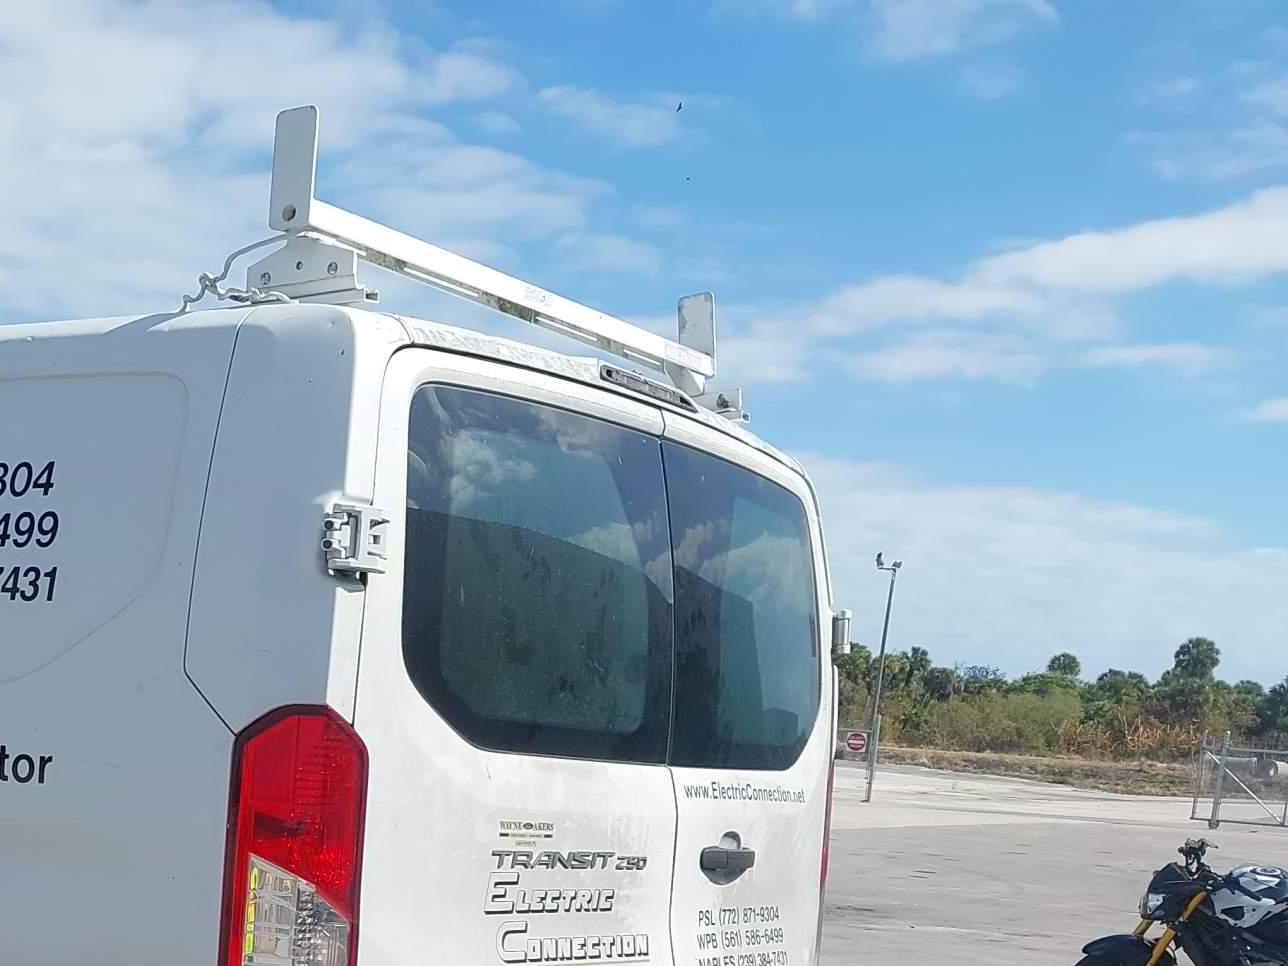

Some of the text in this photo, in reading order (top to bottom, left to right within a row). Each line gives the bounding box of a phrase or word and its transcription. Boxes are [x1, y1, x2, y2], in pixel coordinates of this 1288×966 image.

[684, 781, 806, 803] www.ElectricConnection.net
[533, 823, 554, 831] AKERS
[491, 851, 616, 870] TRANSIT
[484, 872, 615, 915] ELECTRIC
[698, 906, 779, 926] PSL (772) 871-9304
[496, 921, 649, 963] CONNECTION
[697, 927, 784, 950] WPB (561) 586-6499
